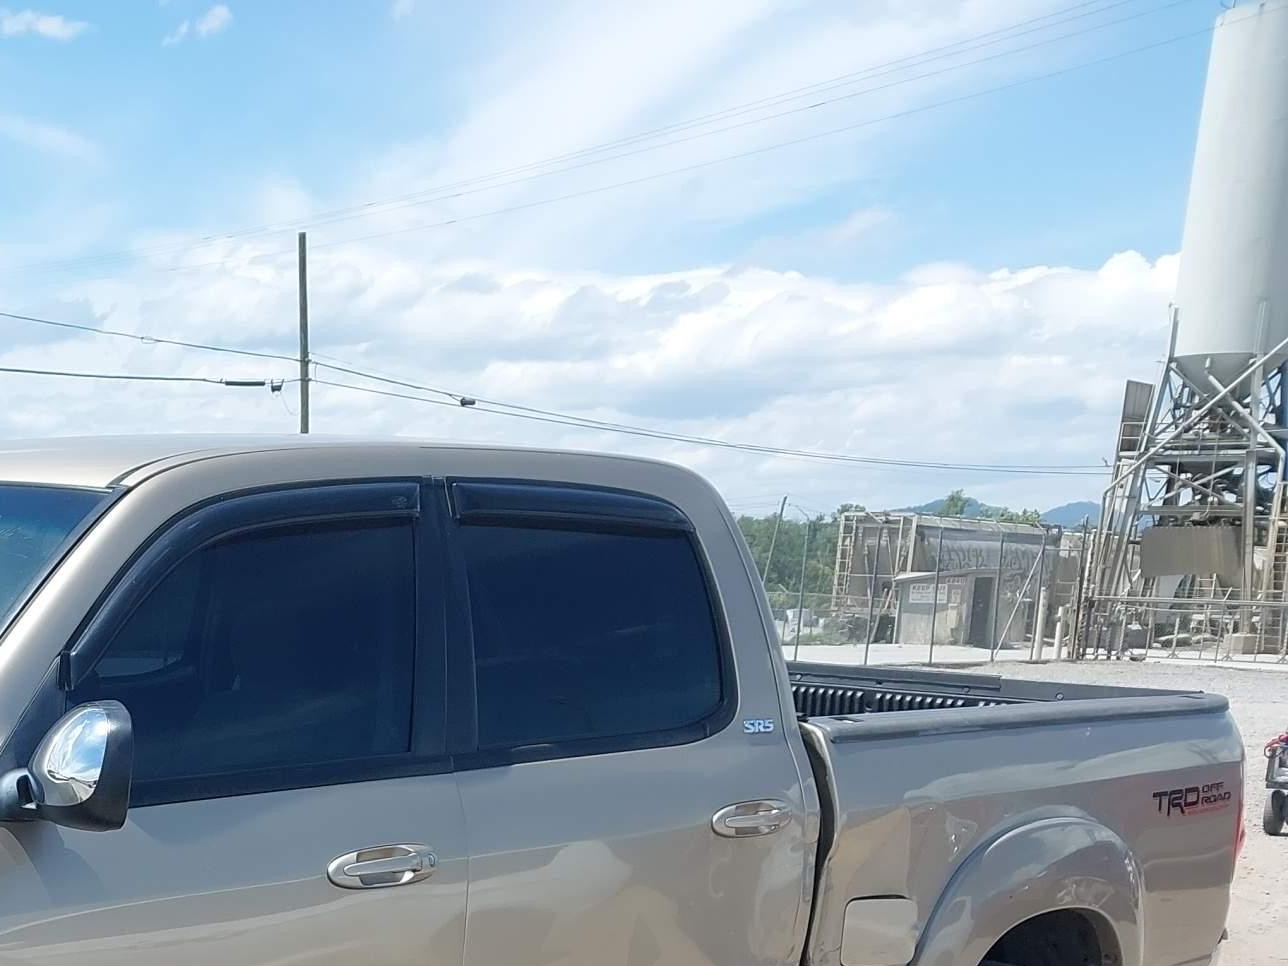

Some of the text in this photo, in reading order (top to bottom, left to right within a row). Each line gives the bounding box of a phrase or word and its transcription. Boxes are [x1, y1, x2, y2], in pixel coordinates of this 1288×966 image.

[743, 719, 775, 734] SR5
[1152, 781, 1224, 816] TRD OFF
[1201, 791, 1231, 805] ROAD
